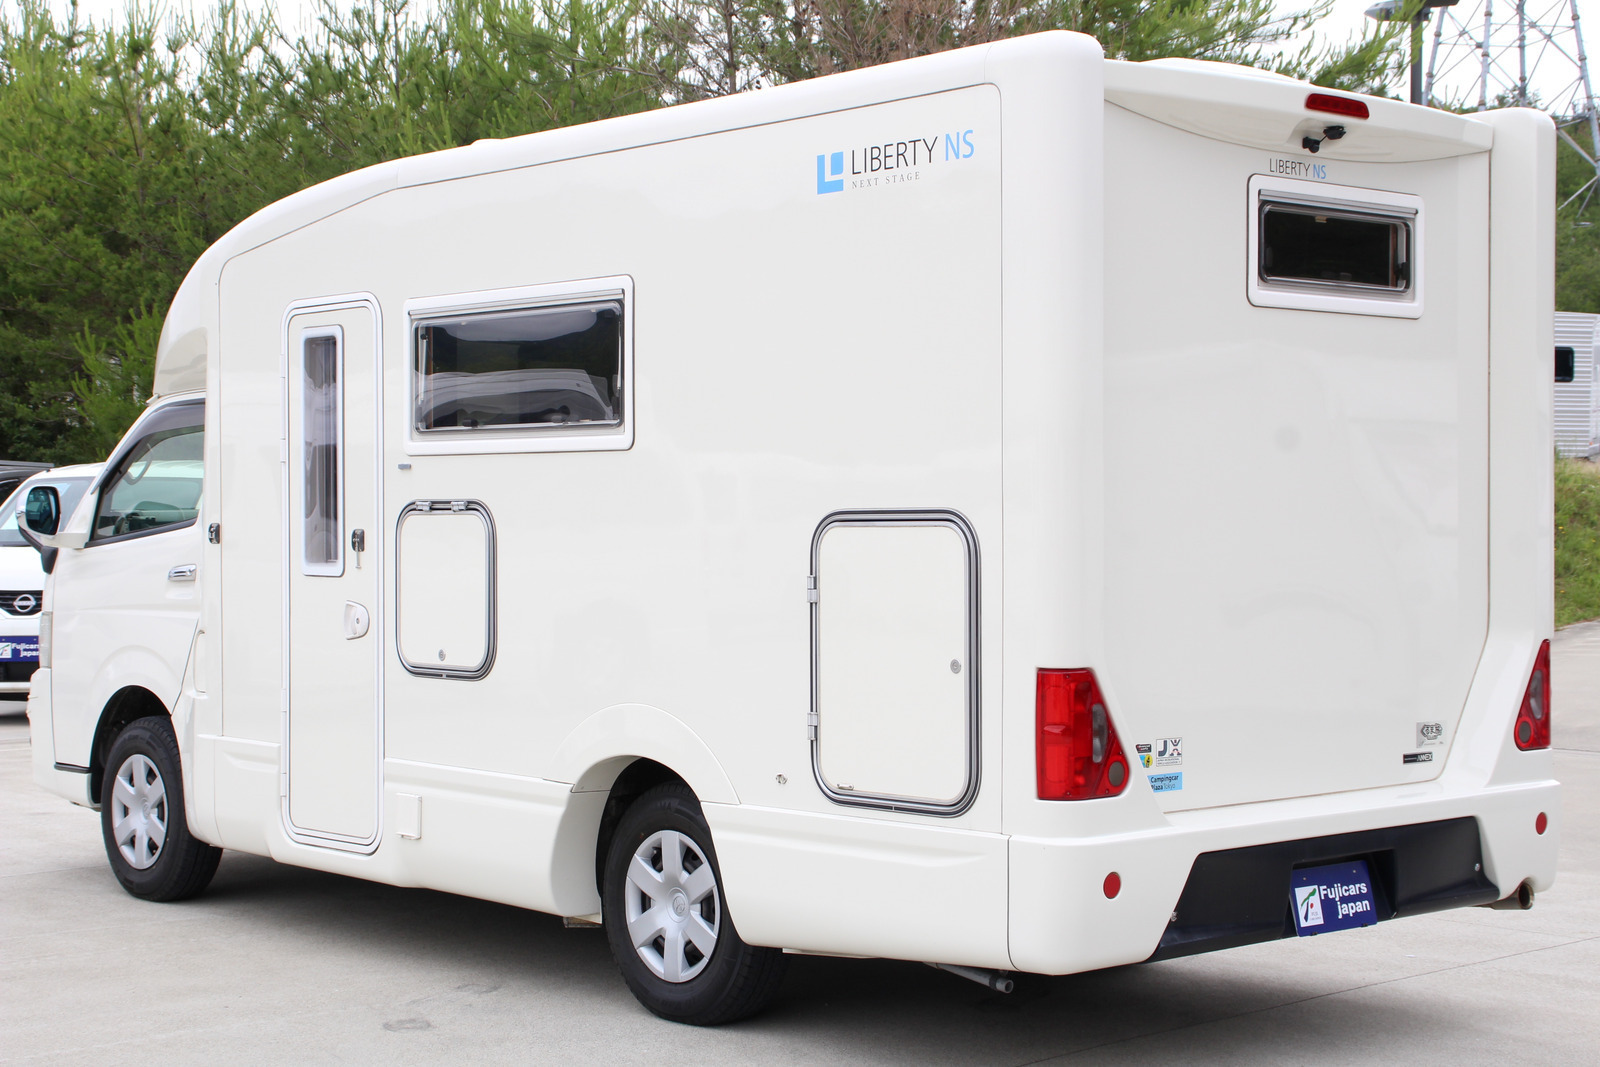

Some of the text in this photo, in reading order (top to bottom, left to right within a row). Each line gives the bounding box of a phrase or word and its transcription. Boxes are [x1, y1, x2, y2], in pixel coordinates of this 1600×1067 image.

[851, 129, 975, 175] LIBERTY NS
[1269, 158, 1327, 180] LIBERTY NS
[851, 171, 921, 190] NEXT STAGE
[11, 642, 40, 651] Fujicar
[1150, 775, 1179, 784] Campingcar
[1319, 883, 1368, 901] Fujicars
[1337, 900, 1371, 919] japan
